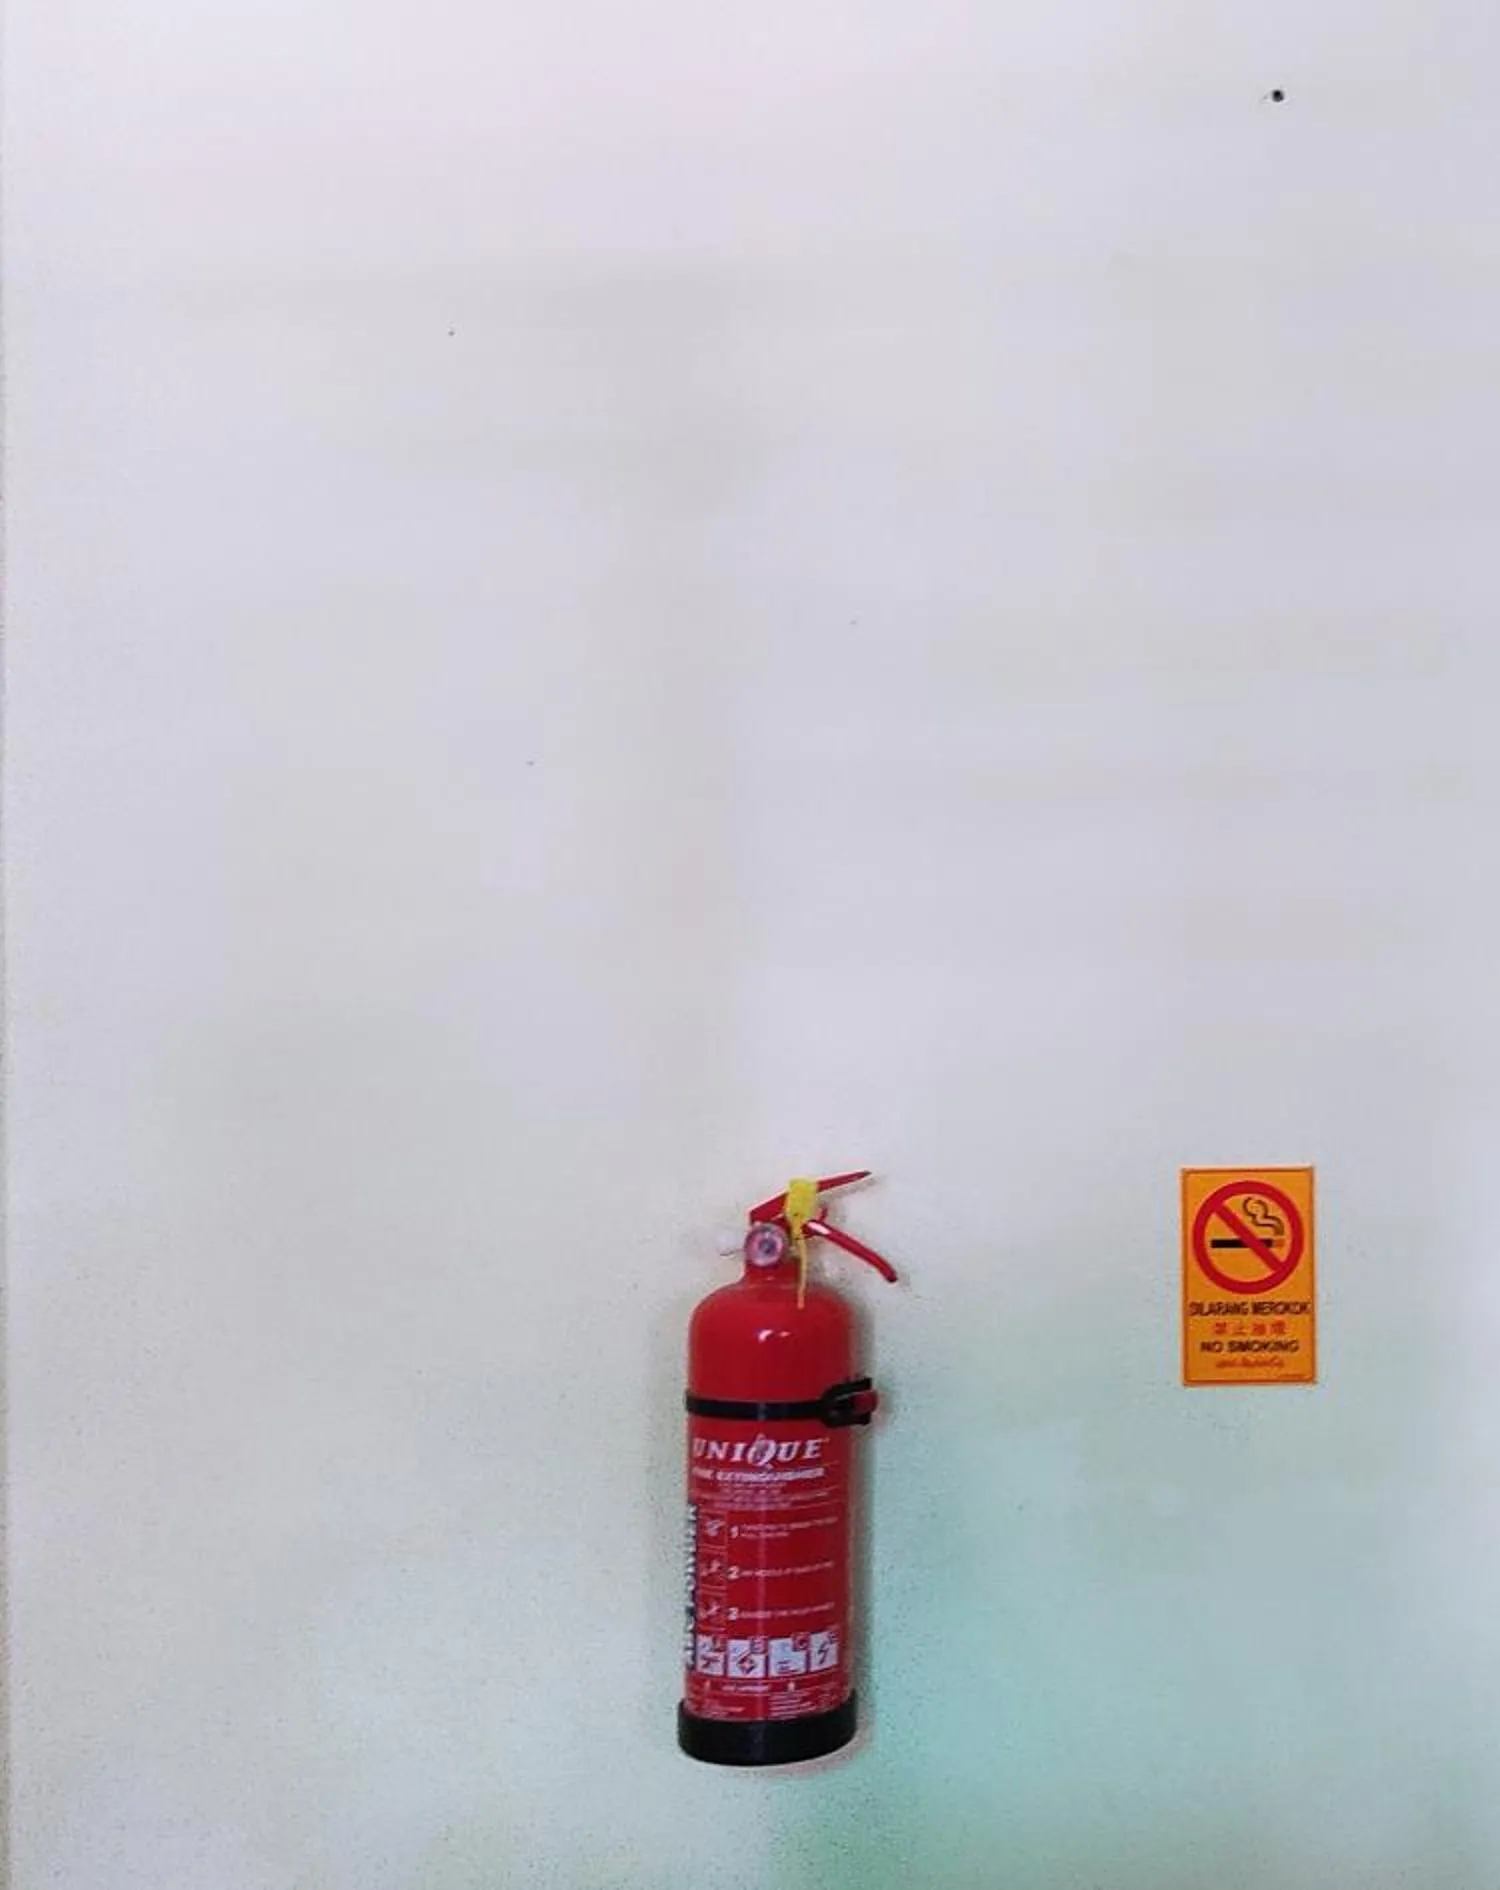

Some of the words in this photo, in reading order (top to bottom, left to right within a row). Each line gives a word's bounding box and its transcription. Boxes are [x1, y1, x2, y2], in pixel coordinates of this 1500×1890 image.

[1201, 1341, 1223, 1353] NO
[1227, 1340, 1300, 1353] SMOKING
[692, 1433, 823, 1470] UNIQUE
